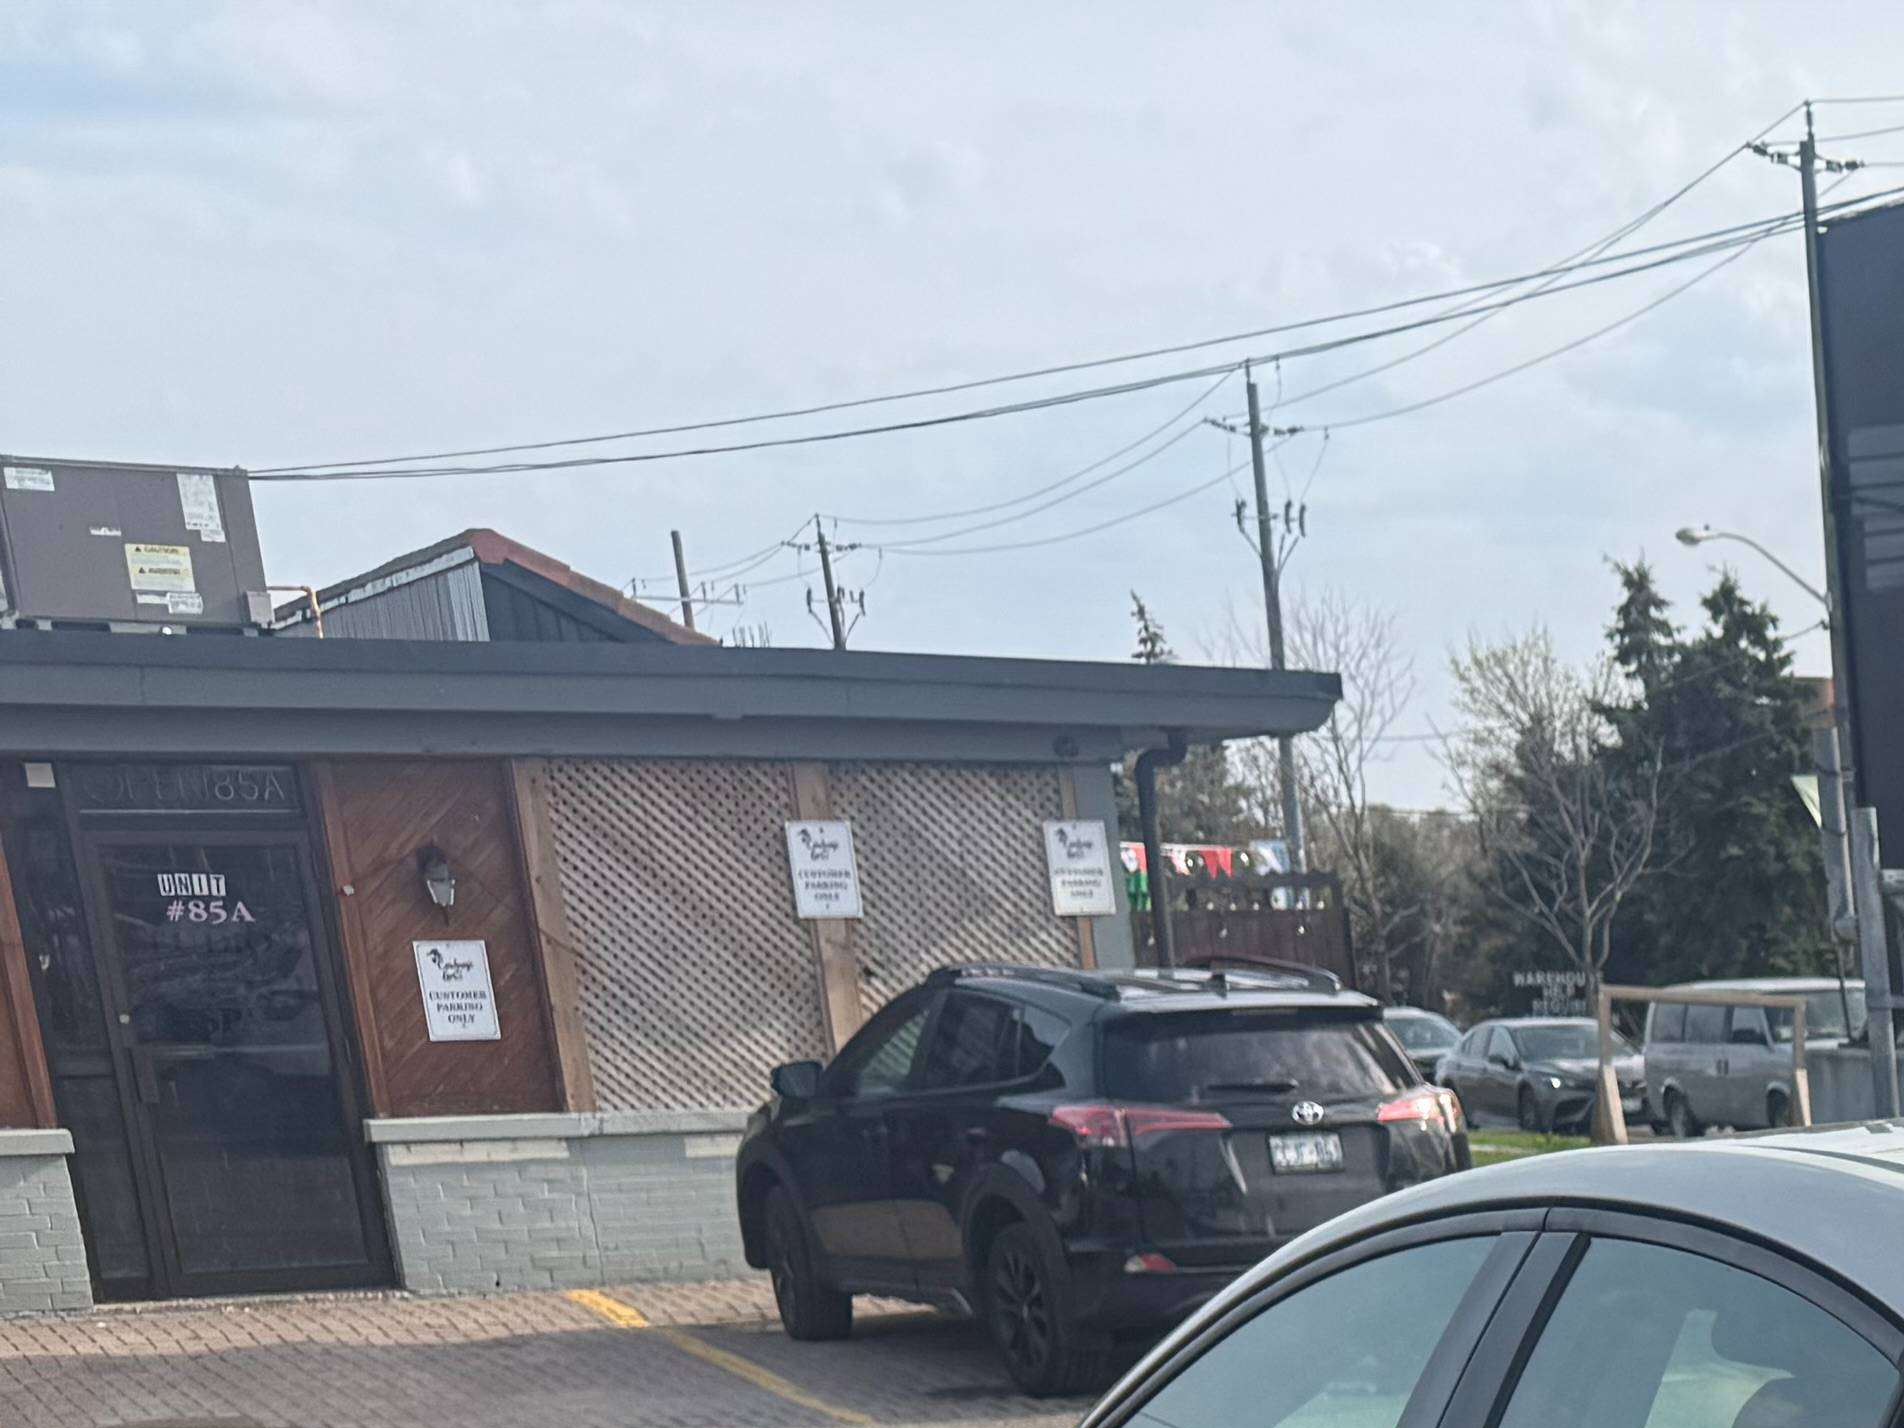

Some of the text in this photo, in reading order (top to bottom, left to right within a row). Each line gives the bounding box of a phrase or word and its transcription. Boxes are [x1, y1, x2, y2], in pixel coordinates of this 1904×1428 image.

[157, 873, 227, 897] UNIT
[166, 899, 257, 925] #85A
[428, 991, 487, 1001] CUSTOMER
[436, 1002, 484, 1013] PARKING
[447, 1013, 476, 1024] ONLY
